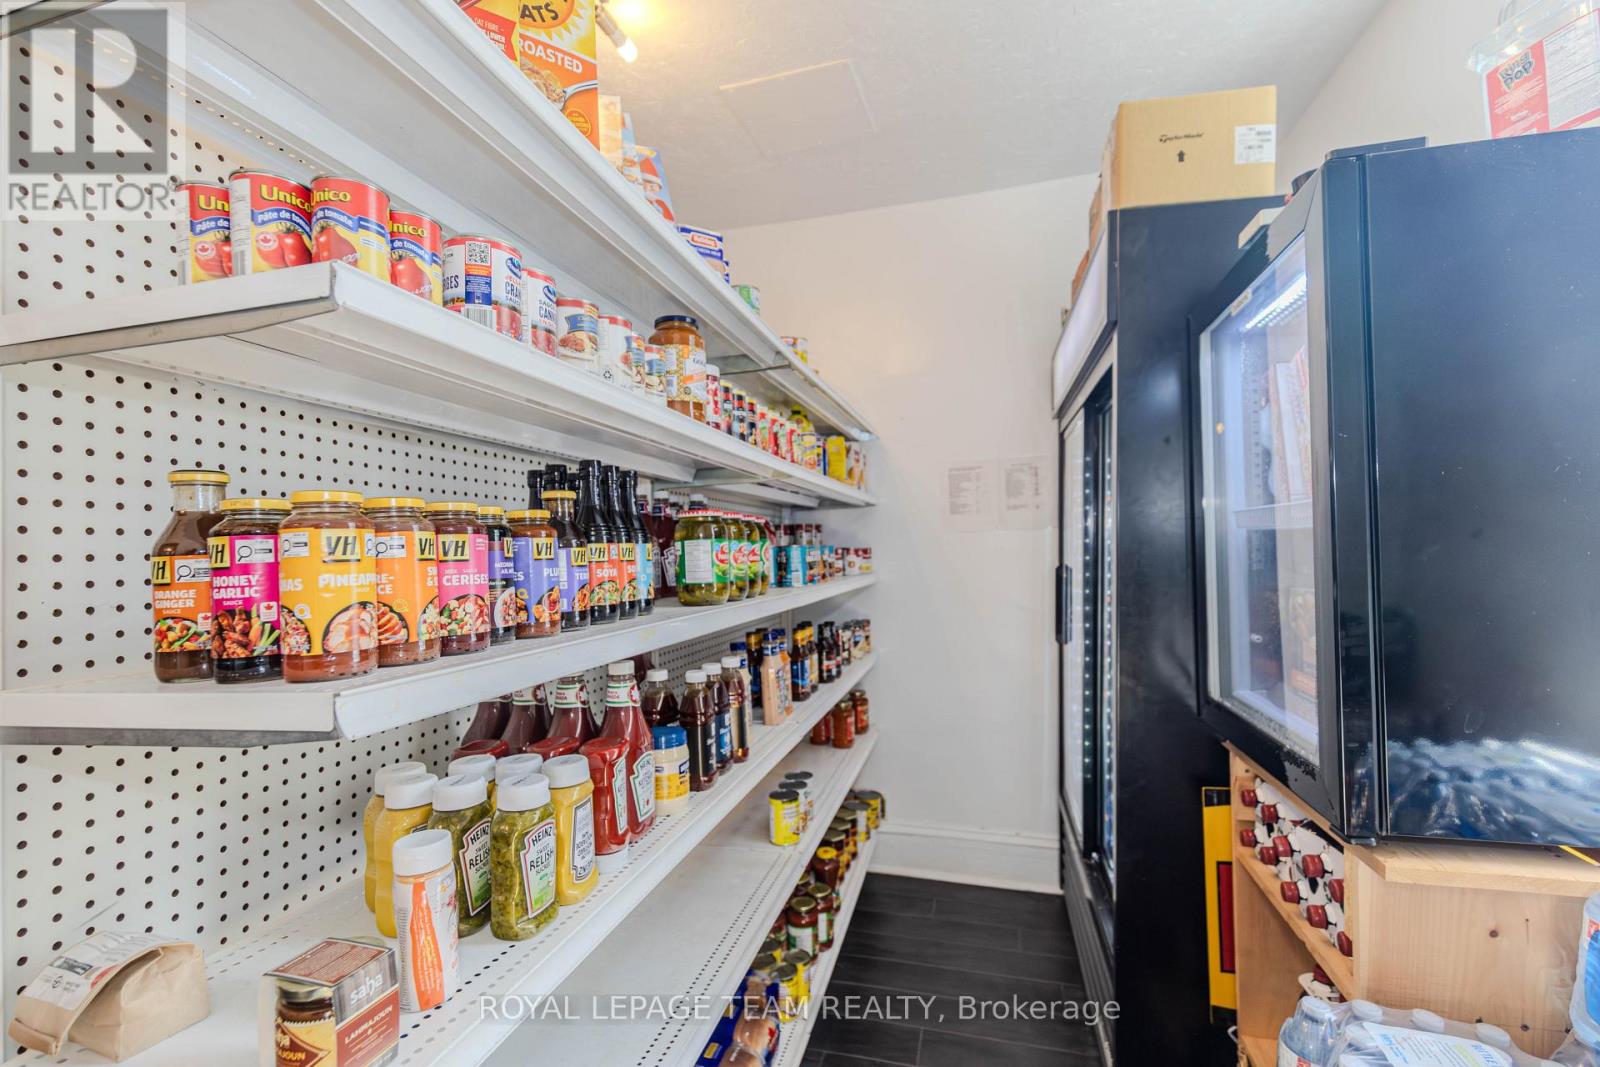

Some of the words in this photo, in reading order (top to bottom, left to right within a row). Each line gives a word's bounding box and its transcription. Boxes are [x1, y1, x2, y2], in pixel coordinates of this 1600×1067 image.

[260, 184, 312, 213] Unico
[326, 535, 357, 556] VH
[441, 540, 466, 558] VH
[535, 542, 552, 557] VH
[589, 547, 606, 559] VH
[621, 547, 633, 558] VH
[573, 550, 586, 563] VH
[213, 574, 260, 587] HONEY
[213, 587, 261, 599] GARLIC
[470, 826, 490, 845] HEINZ
[532, 826, 552, 846] HEINZ
